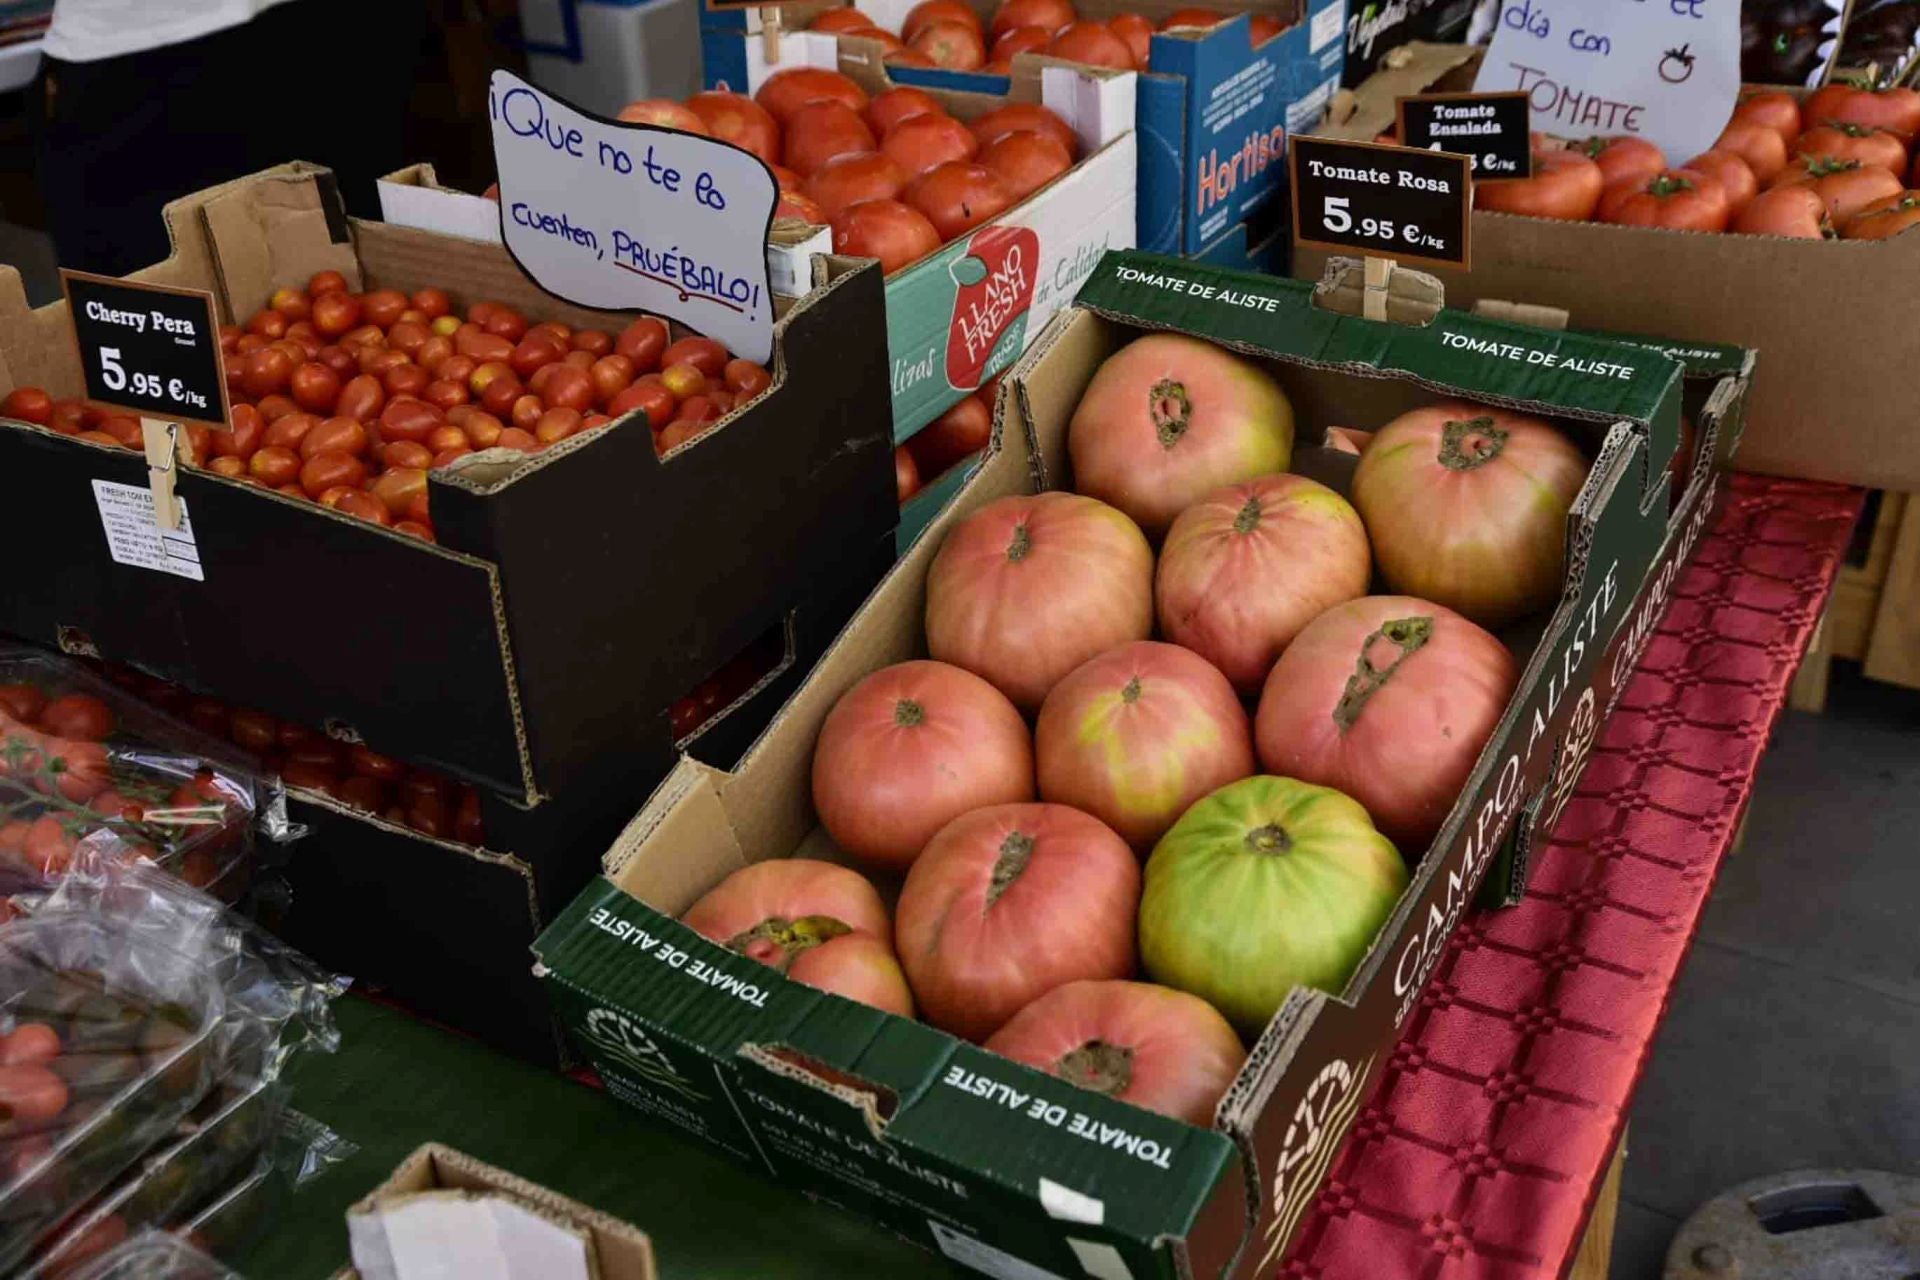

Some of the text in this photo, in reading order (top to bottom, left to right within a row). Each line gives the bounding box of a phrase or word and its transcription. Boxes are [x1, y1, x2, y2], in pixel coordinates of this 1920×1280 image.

[1569, 29, 1611, 56] con
[1433, 104, 1496, 120] Tomate
[1509, 62, 1646, 132] TOMATE
[1428, 121, 1503, 137] Ensalada
[599, 139, 633, 175] no
[642, 145, 681, 192] te
[695, 171, 726, 211] lo
[1308, 160, 1451, 194] Tomate Rosa
[1322, 195, 1445, 250] 5.95 €/kg
[86, 300, 196, 335] Cherry Pera
[957, 244, 1022, 341] LLANO
[965, 267, 1027, 364] FRESH
[1115, 265, 1280, 313] TOMATE DE ALISTE
[99, 346, 207, 409] 5.95 €/kg
[1440, 331, 1635, 380] TOMATE DE ALISTE
[1394, 558, 1619, 997] CAMPO ALISTE
[589, 908, 770, 1008] TOMATE DE ALISTE
[943, 1065, 1173, 1169] TOMATE DE ALISTE
